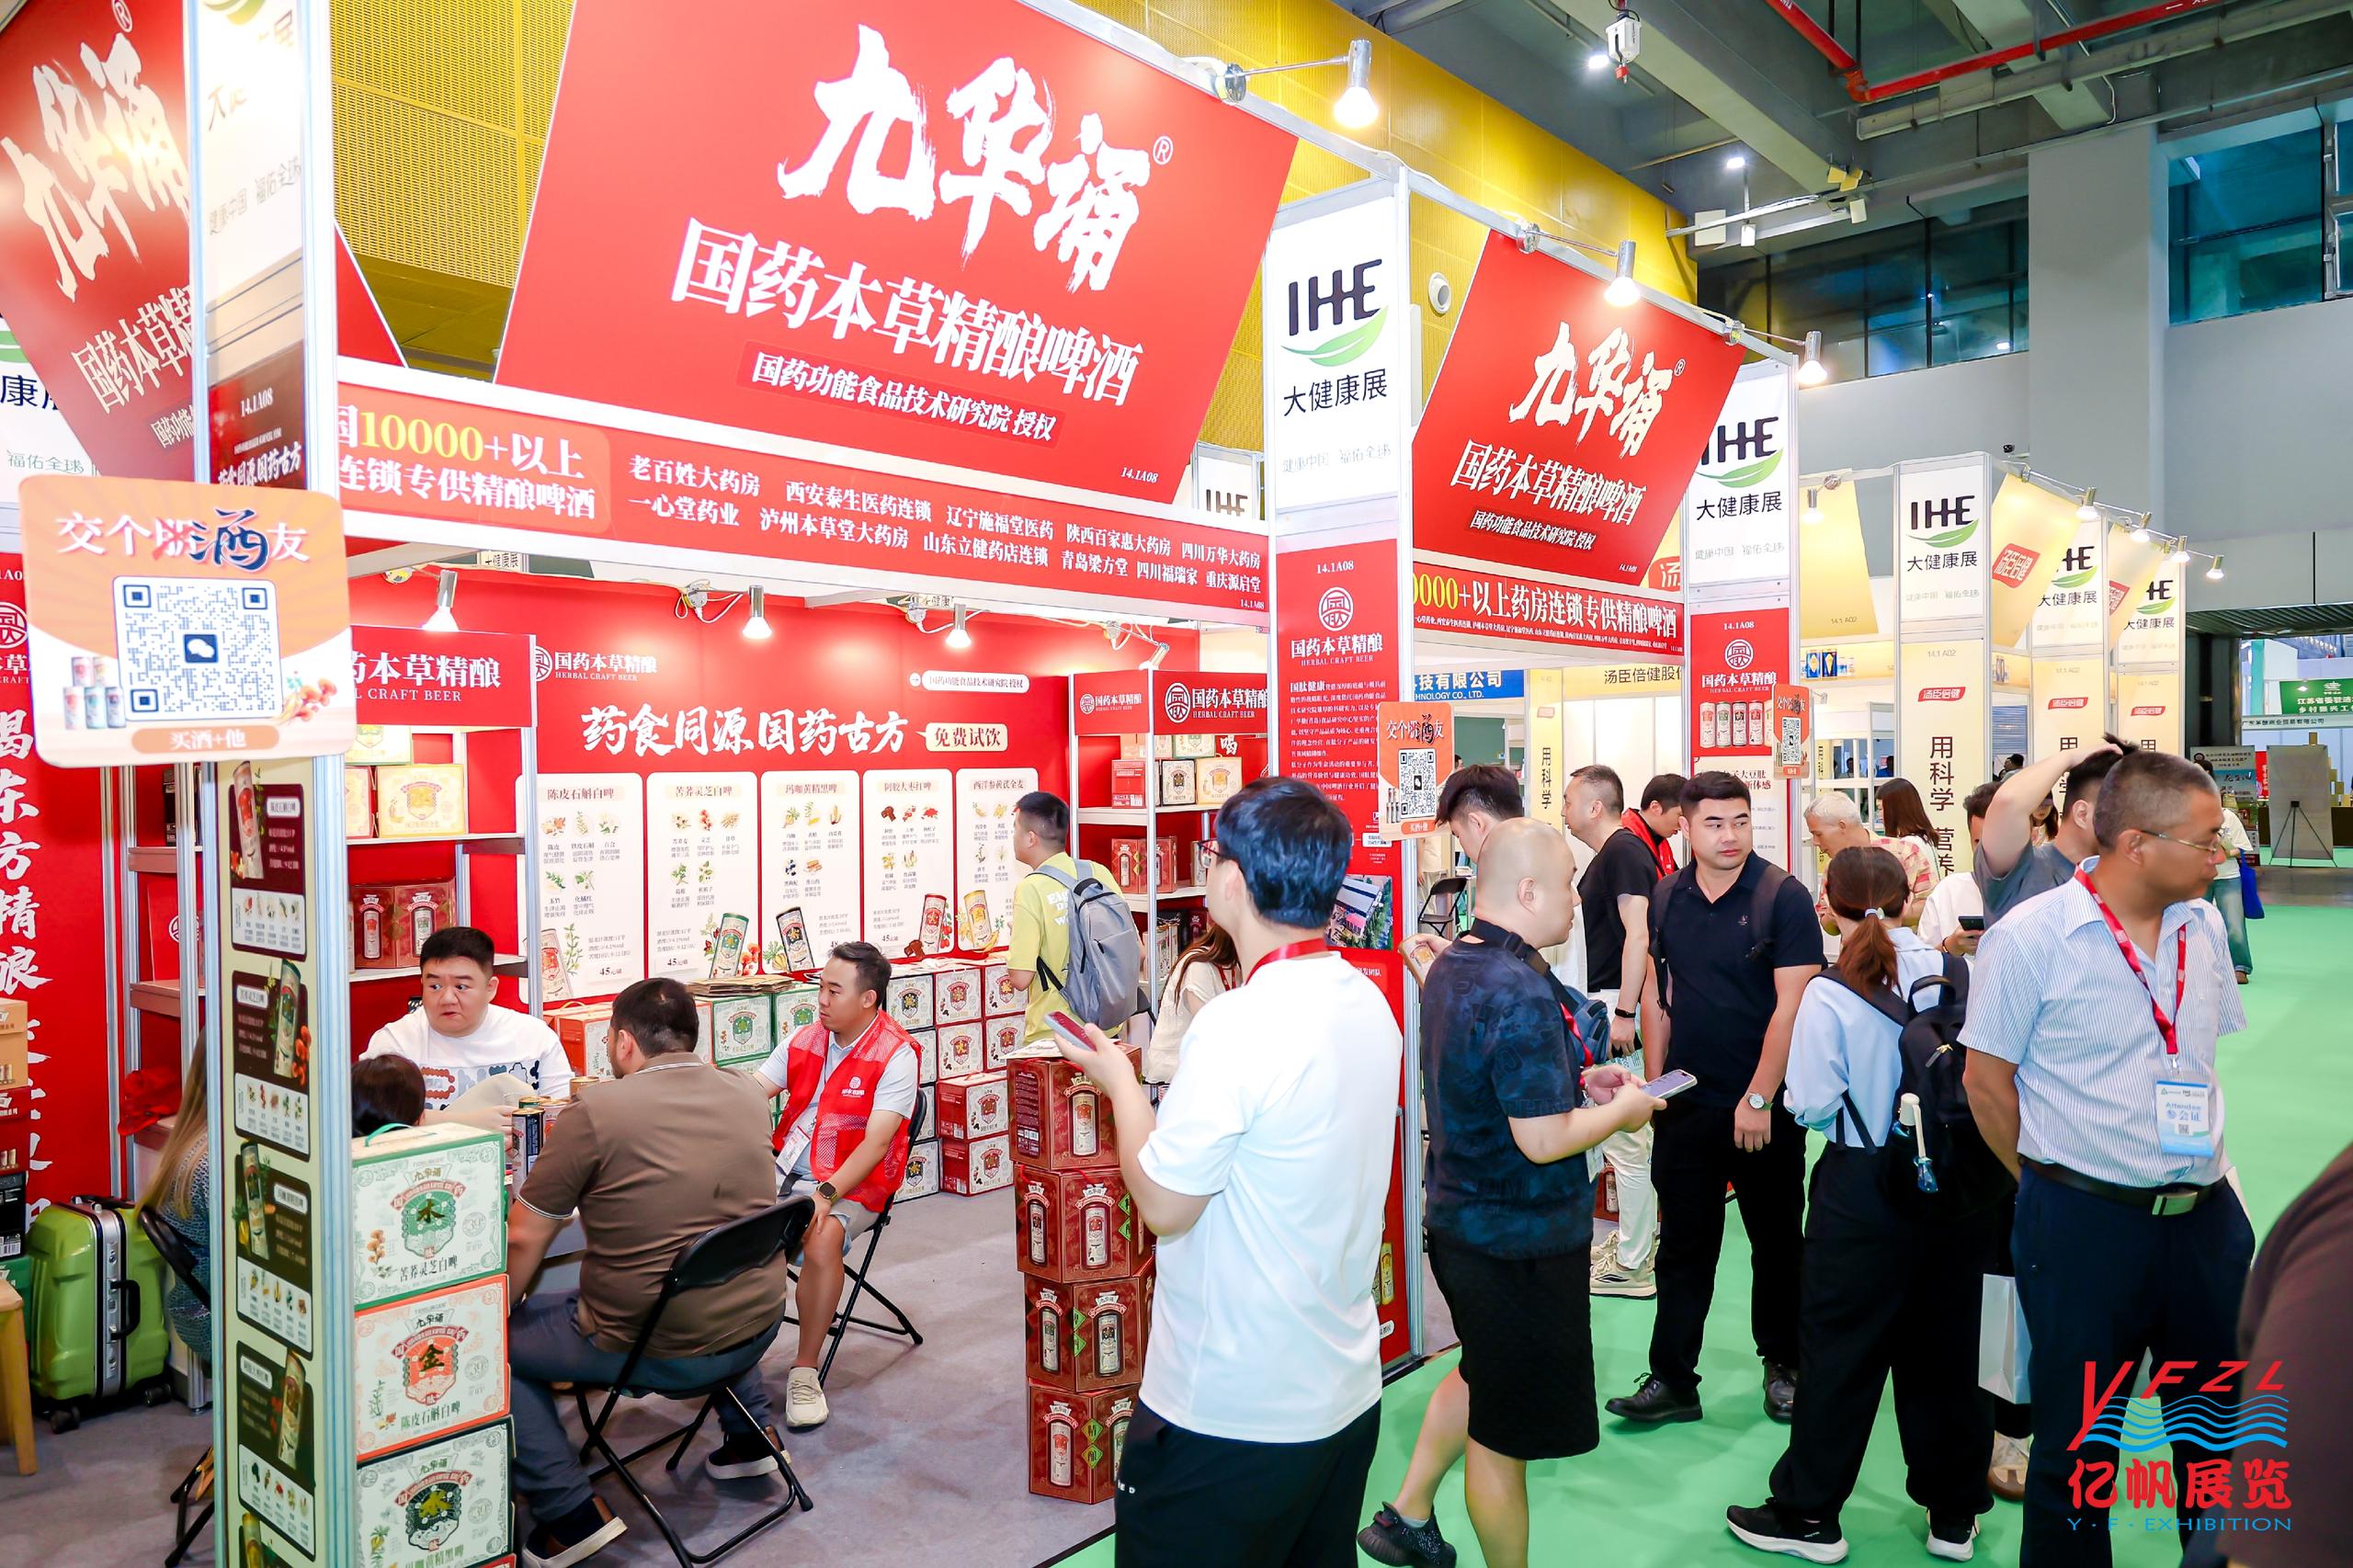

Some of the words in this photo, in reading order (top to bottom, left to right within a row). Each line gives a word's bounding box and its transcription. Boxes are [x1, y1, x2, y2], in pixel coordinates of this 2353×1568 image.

[1289, 258, 1382, 336] IHE
[672, 217, 1143, 407] 国药本草精酿啤酒
[752, 350, 1012, 433] 国药功能食品技术研究院
[1013, 399, 1057, 443] 授权
[1283, 368, 1388, 417] 大健康展
[7, 448, 85, 476] 福佑全球
[1120, 465, 1159, 484] 14.1A08
[1450, 438, 1648, 526] 国药本草精酿啤酒
[339, 456, 597, 520] 连锁专供精酿啤酒
[629, 454, 761, 497] 老百姓大药房
[786, 479, 931, 523] 西安泰生医药连锁
[946, 505, 1054, 540] 辽宁施福堂医药
[1065, 523, 1171, 558] 陕西百家惠大药房
[1181, 540, 1261, 571] 四川万华大药房
[1696, 491, 1782, 521] 大健康展
[1910, 494, 1975, 530] IHE
[629, 494, 741, 528] 一心堂药业
[760, 506, 910, 551] 泸州本草堂大药房
[923, 535, 1049, 568] 山东立健药店连锁
[1061, 550, 1130, 578] 青岛梁方堂
[1135, 561, 1199, 588] 四川福瑞家
[1205, 569, 1262, 596] 重庆源启堂
[1574, 530, 1597, 551] 授权
[1316, 560, 1355, 574] 14.1A08
[1907, 551, 1978, 573] 大健康展
[2038, 590, 2097, 608] 大健康展
[1723, 620, 1755, 631] 14.1A08
[2124, 617, 2175, 631] 大健康展
[1290, 632, 1383, 660] 国药本草精酿
[554, 653, 659, 675] 国药本草精酿
[1301, 657, 1329, 666] HERBAL
[1330, 655, 1353, 665] CRAFT
[1355, 654, 1373, 663] BEER
[590, 673, 614, 681] CRAFT
[616, 674, 638, 682] BEER
[1415, 671, 1502, 691] 技有限公司
[1701, 672, 1778, 688] 国药本草精酿
[368, 688, 418, 700] CRAFT
[425, 690, 461, 701] BEER
[1192, 688, 1268, 709] 国药本草精酿
[1469, 689, 1484, 699] LTD.
[1192, 710, 1217, 719] HERBAL
[1219, 710, 1239, 719] CRAFT
[1240, 710, 1256, 719] BEER
[581, 703, 908, 757] 药食同源国药古方
[934, 726, 1002, 748] 免费试饮
[1541, 747, 1552, 810] 用科学
[1930, 736, 1954, 812] 用科学
[547, 788, 614, 801] 陈皮石斛白啤
[676, 785, 733, 798] 苦荞灵芝白啤
[400, 1255, 458, 1282] 苦荞灵芝白啤
[401, 1401, 460, 1430] 陈皮石斛白啤
